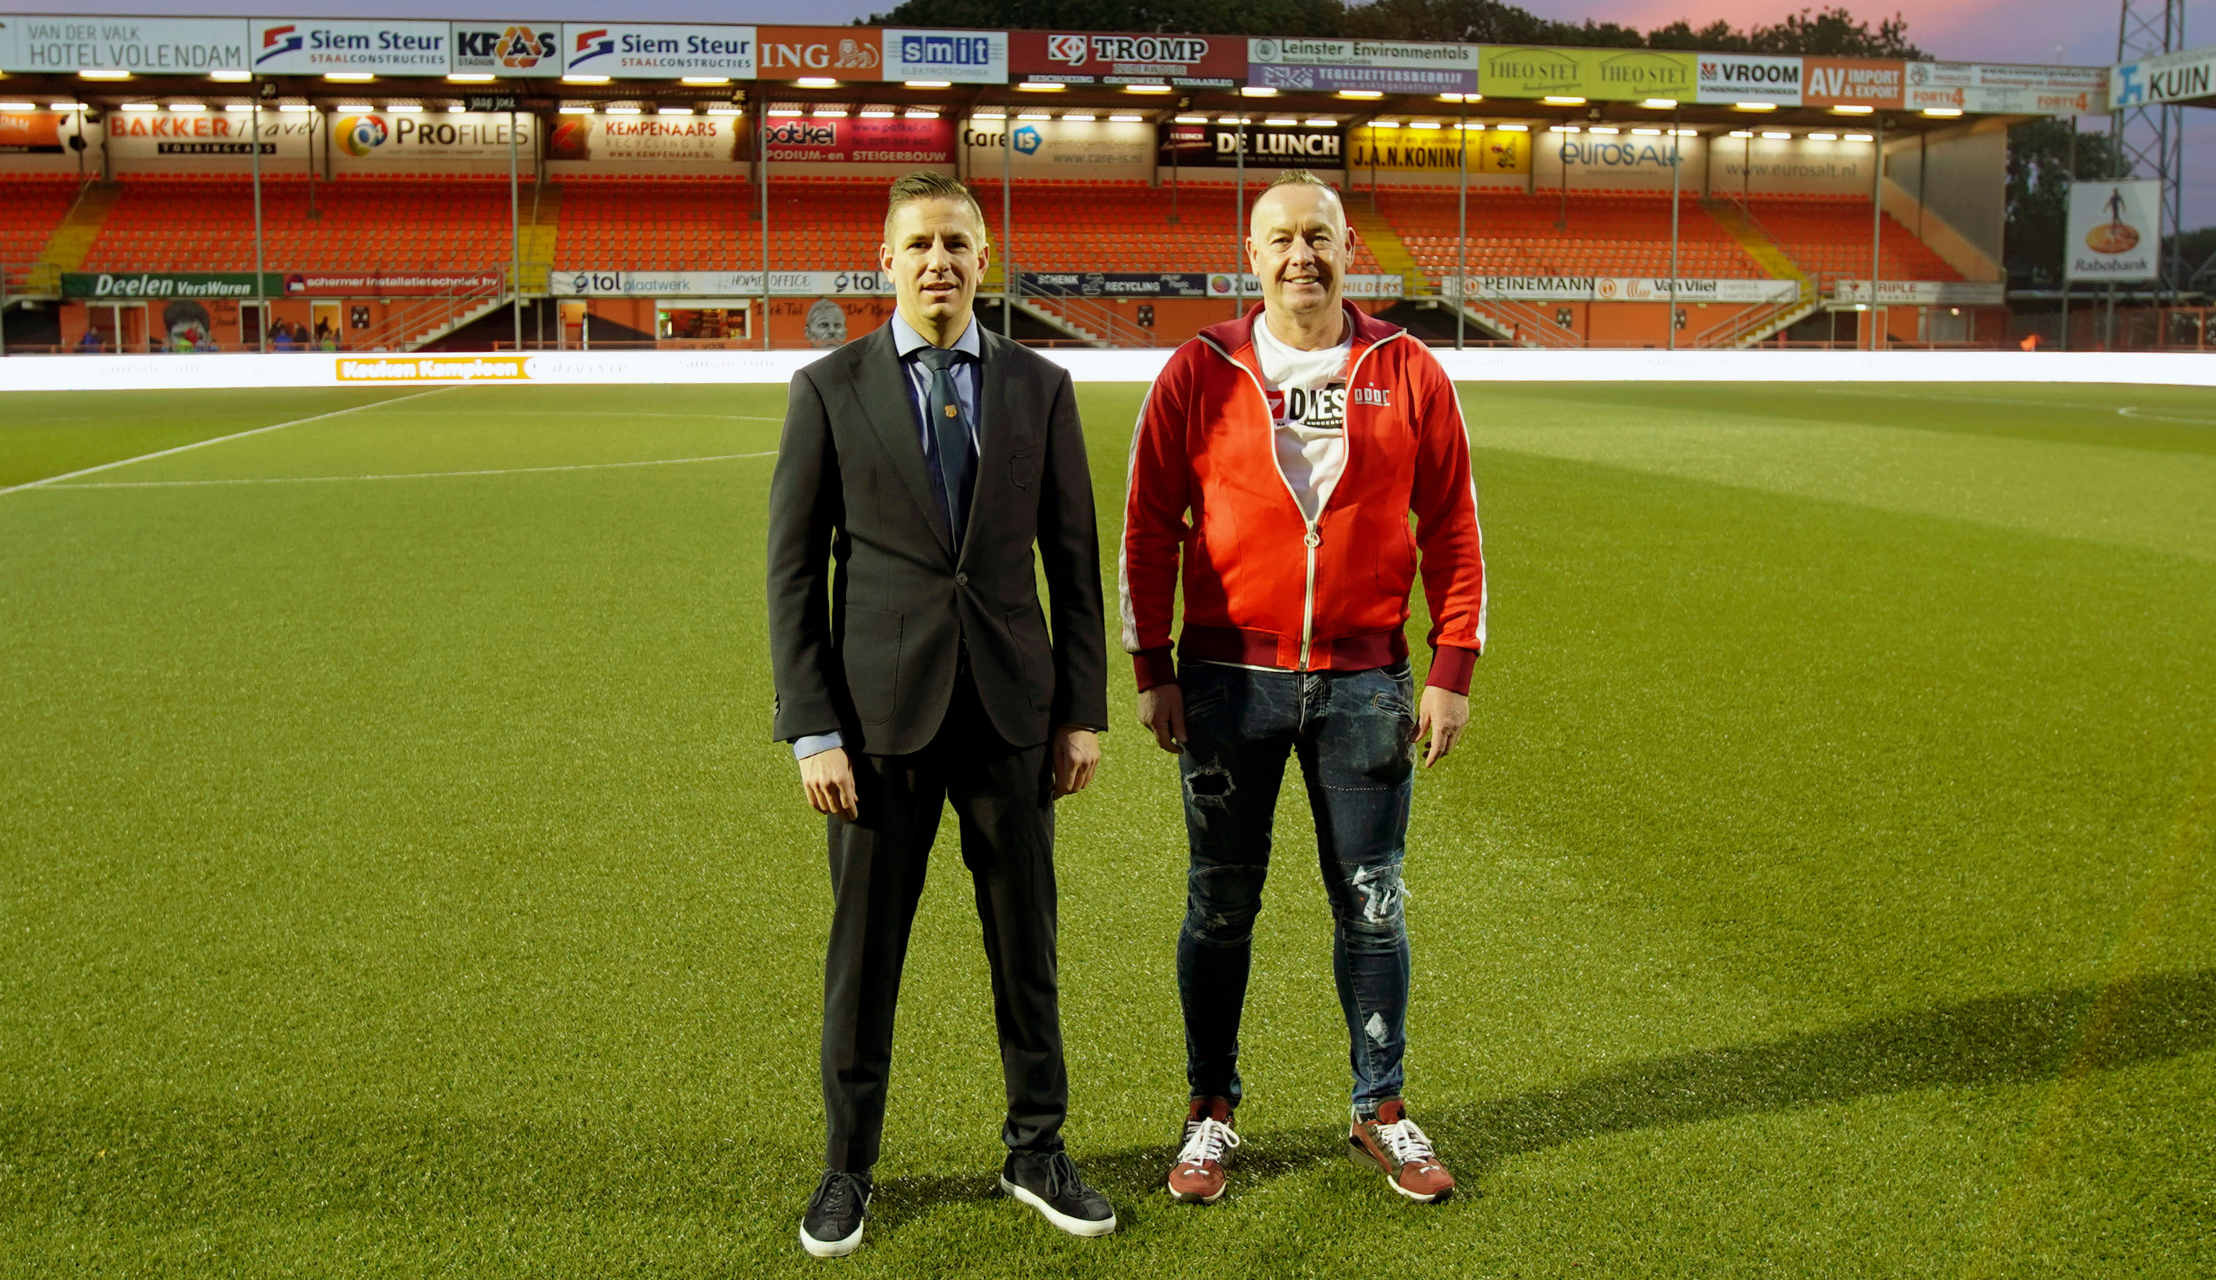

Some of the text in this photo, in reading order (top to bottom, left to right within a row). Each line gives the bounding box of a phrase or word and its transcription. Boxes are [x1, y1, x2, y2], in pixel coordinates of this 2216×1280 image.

[28, 24, 140, 41] VAN DER VALK
[310, 29, 444, 50] Siem Steur
[458, 30, 557, 58] KRAS
[621, 34, 750, 54] Siem Steur
[904, 38, 987, 63] smit
[1092, 35, 1209, 63] TROMP
[1281, 39, 1469, 61] Leinster Environmentals
[30, 43, 241, 68] HOTEL VOLENDAM
[310, 54, 446, 65] STAALCONSTRUCTIES
[458, 57, 495, 67] STADION
[621, 58, 752, 68] STAALCONSTRUCTIES
[760, 43, 830, 69] ING
[1489, 60, 1579, 80] THEO STET
[1601, 64, 1687, 83] THEO STET
[1722, 63, 1799, 83] VROOM
[1848, 69, 1900, 84] IMPORT
[1808, 67, 1846, 97] AV
[2149, 63, 2210, 99] KUIN
[1856, 86, 1900, 98] EXPORT
[111, 116, 231, 137] BAKKER
[605, 121, 718, 137] KEMPENAARS
[605, 138, 690, 149] RECYCLING
[1216, 131, 1340, 156] DE LUNCH
[852, 150, 947, 162] STEIGERBOUW
[1725, 161, 1857, 179] www.eurosalt.nl
[2074, 257, 2149, 274] Rabobank
[95, 273, 251, 296] Deelen VersWaren
[306, 277, 363, 287] schermer
[593, 271, 690, 293] tol plaatwerk
[853, 271, 880, 291] tol
[1037, 274, 1079, 285] SCHENK
[1105, 281, 1161, 292] RECYCLING
[1485, 276, 1595, 291] PEINEMANN
[1654, 279, 1718, 292] Van Vliet
[342, 359, 518, 379] Keuken Kampioen
